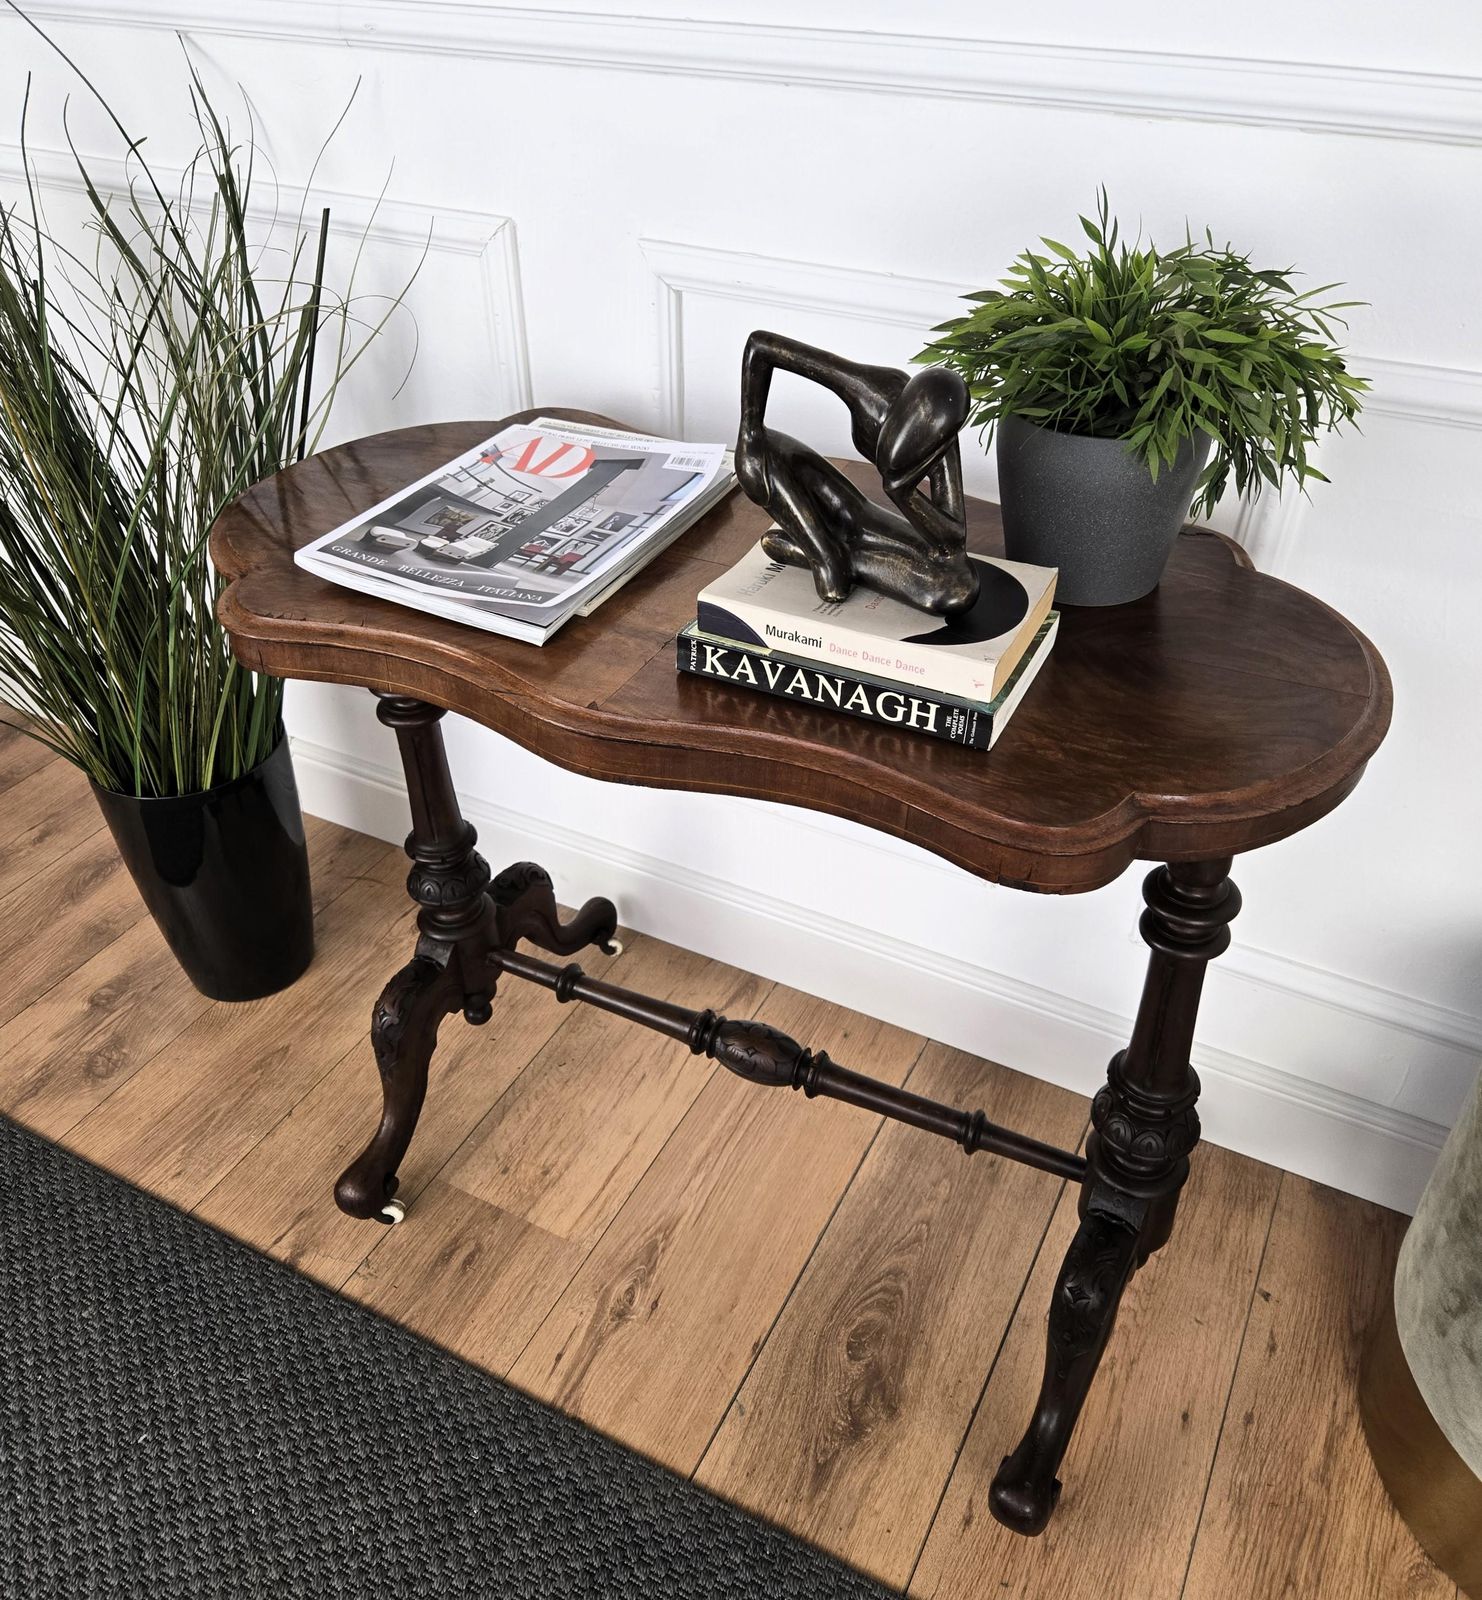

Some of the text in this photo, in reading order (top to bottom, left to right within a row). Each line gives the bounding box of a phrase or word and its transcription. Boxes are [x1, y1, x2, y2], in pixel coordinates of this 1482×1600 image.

[481, 435, 597, 478] AD
[331, 545, 543, 601] GRANDE BELLEZZA ITALIANA
[736, 571, 777, 597] Haruki
[689, 639, 697, 671] PATRICK
[765, 624, 926, 675] Murakami Dance Dance Dance
[702, 644, 940, 732] KAVANAGH
[950, 708, 959, 739] COMPLETE
[957, 715, 965, 735] POEMS
